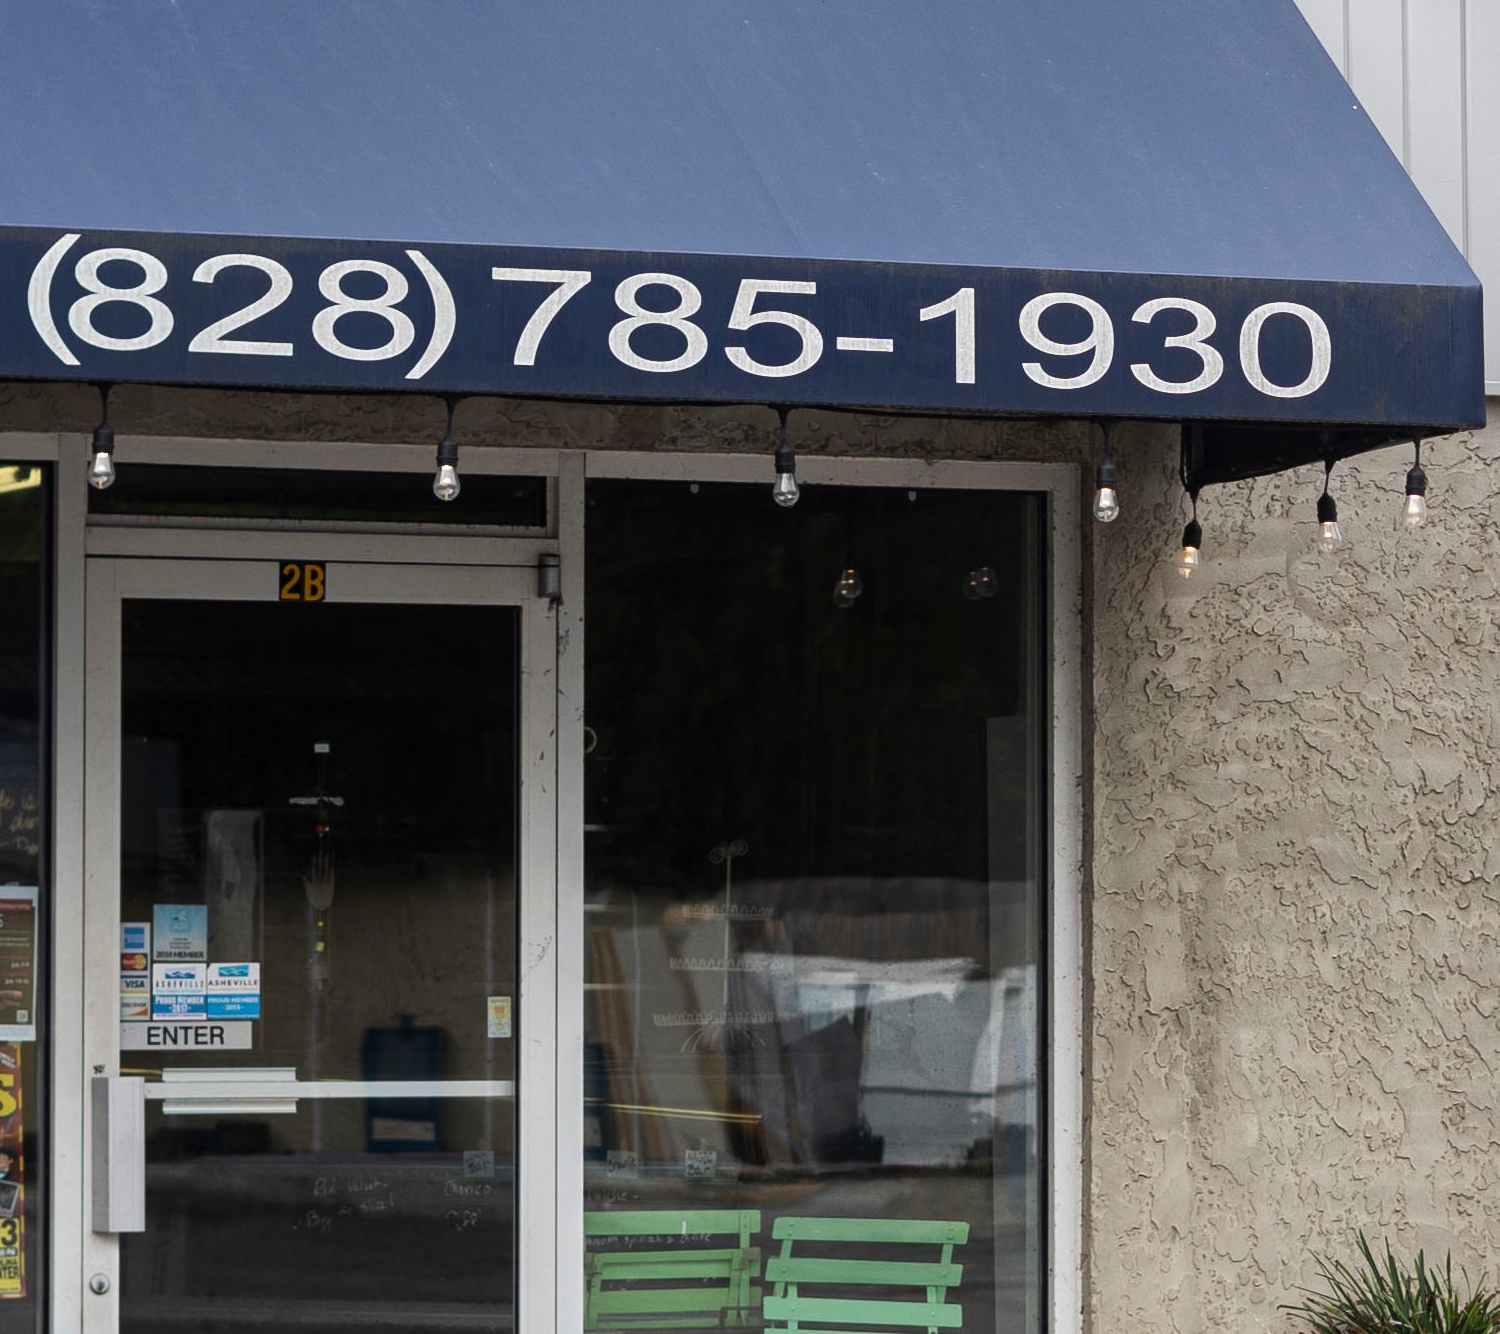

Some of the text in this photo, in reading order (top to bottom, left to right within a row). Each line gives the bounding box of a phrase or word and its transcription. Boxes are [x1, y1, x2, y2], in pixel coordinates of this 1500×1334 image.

[27, 233, 1333, 400] (828) 785-1930
[280, 562, 325, 602] 2B
[124, 980, 145, 988] VISA
[177, 996, 204, 1004] MEMBER
[147, 1026, 224, 1045] ENTER
[1, 1219, 18, 1246] 3
